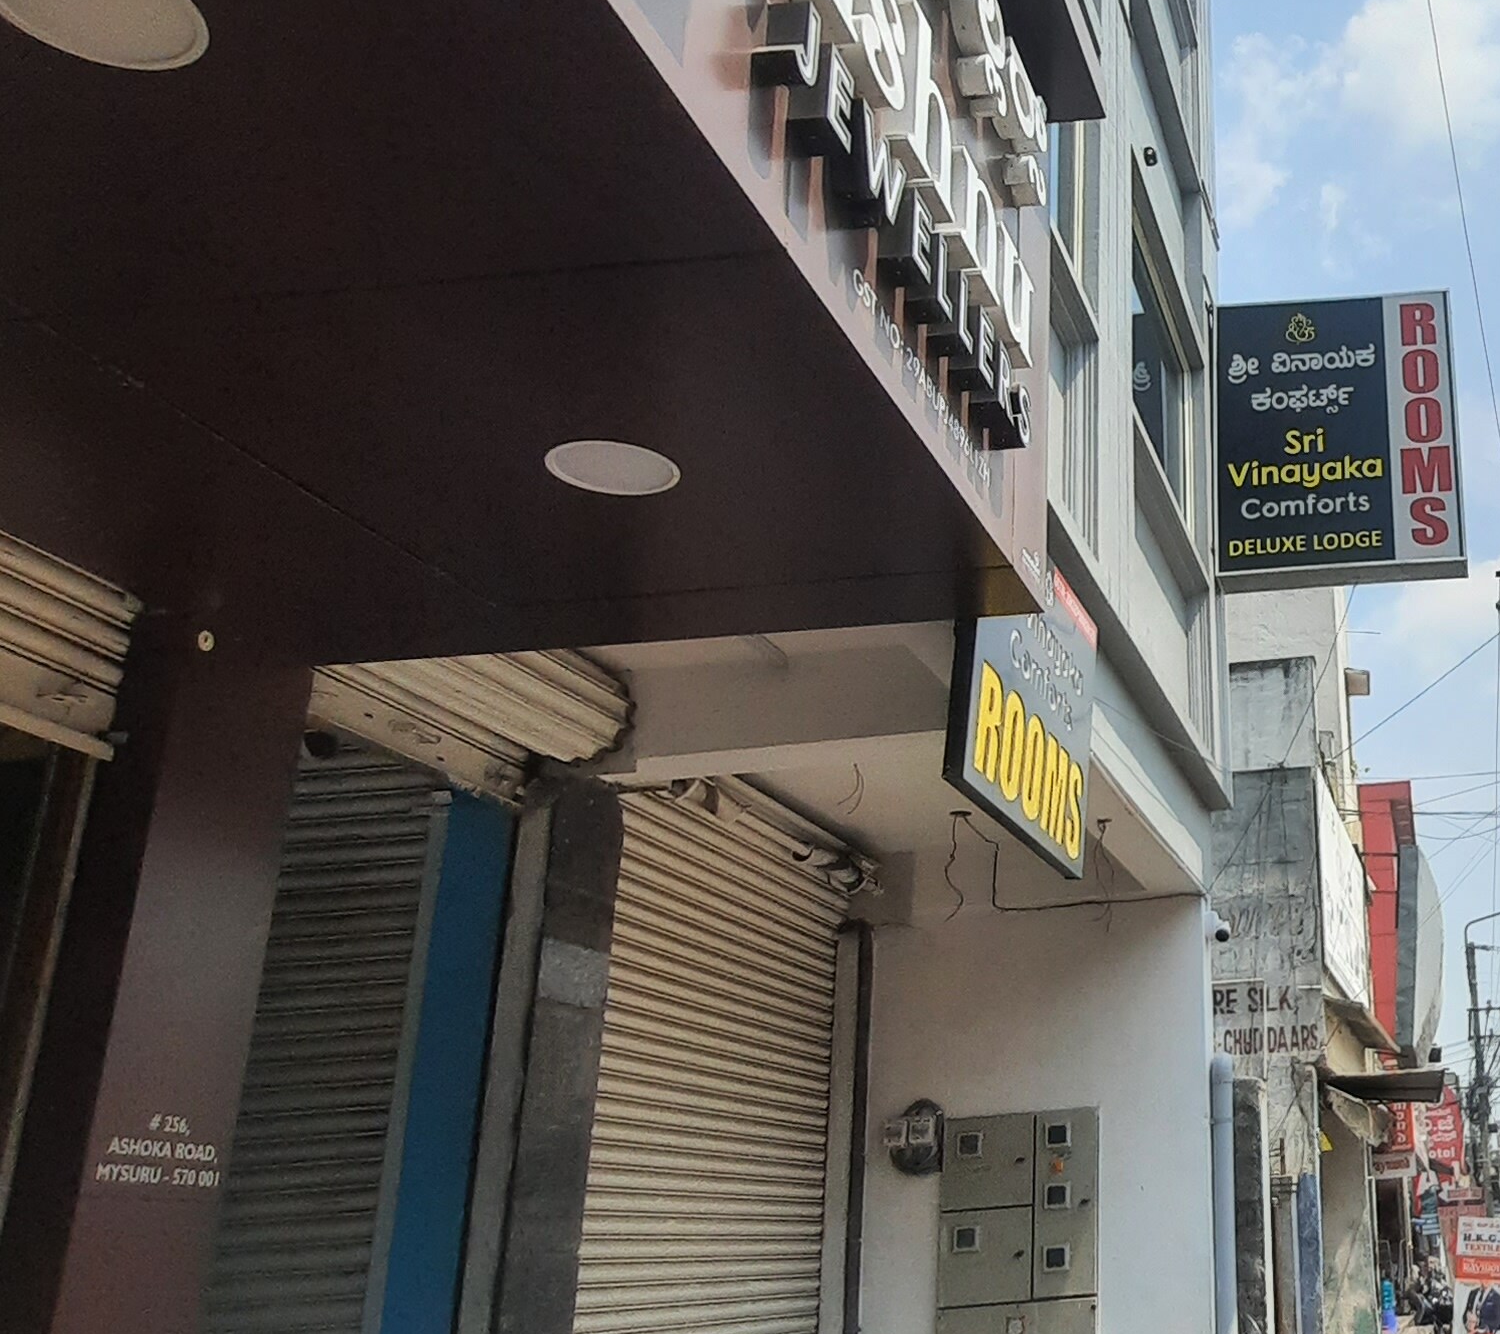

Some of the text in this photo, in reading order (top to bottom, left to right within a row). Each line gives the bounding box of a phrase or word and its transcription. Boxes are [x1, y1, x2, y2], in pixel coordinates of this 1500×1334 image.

[795, 0, 1032, 447] JEWELLERS
[852, 268, 878, 316] GST
[1227, 343, 1376, 385] ಶ್ರೀ ವಿನಾಯಕ
[1283, 427, 1326, 456] Sri
[1399, 302, 1454, 547] ROOMS
[1227, 454, 1384, 488] Vinayaka
[1240, 491, 1371, 519] Comforts
[1228, 530, 1383, 557] DELUXE LODGE
[973, 659, 1085, 861] ROOMS
[106, 1136, 218, 1164] ASHOKA ROAD,
[95, 1162, 163, 1185] MYSURU
[171, 1168, 197, 1186] 570
